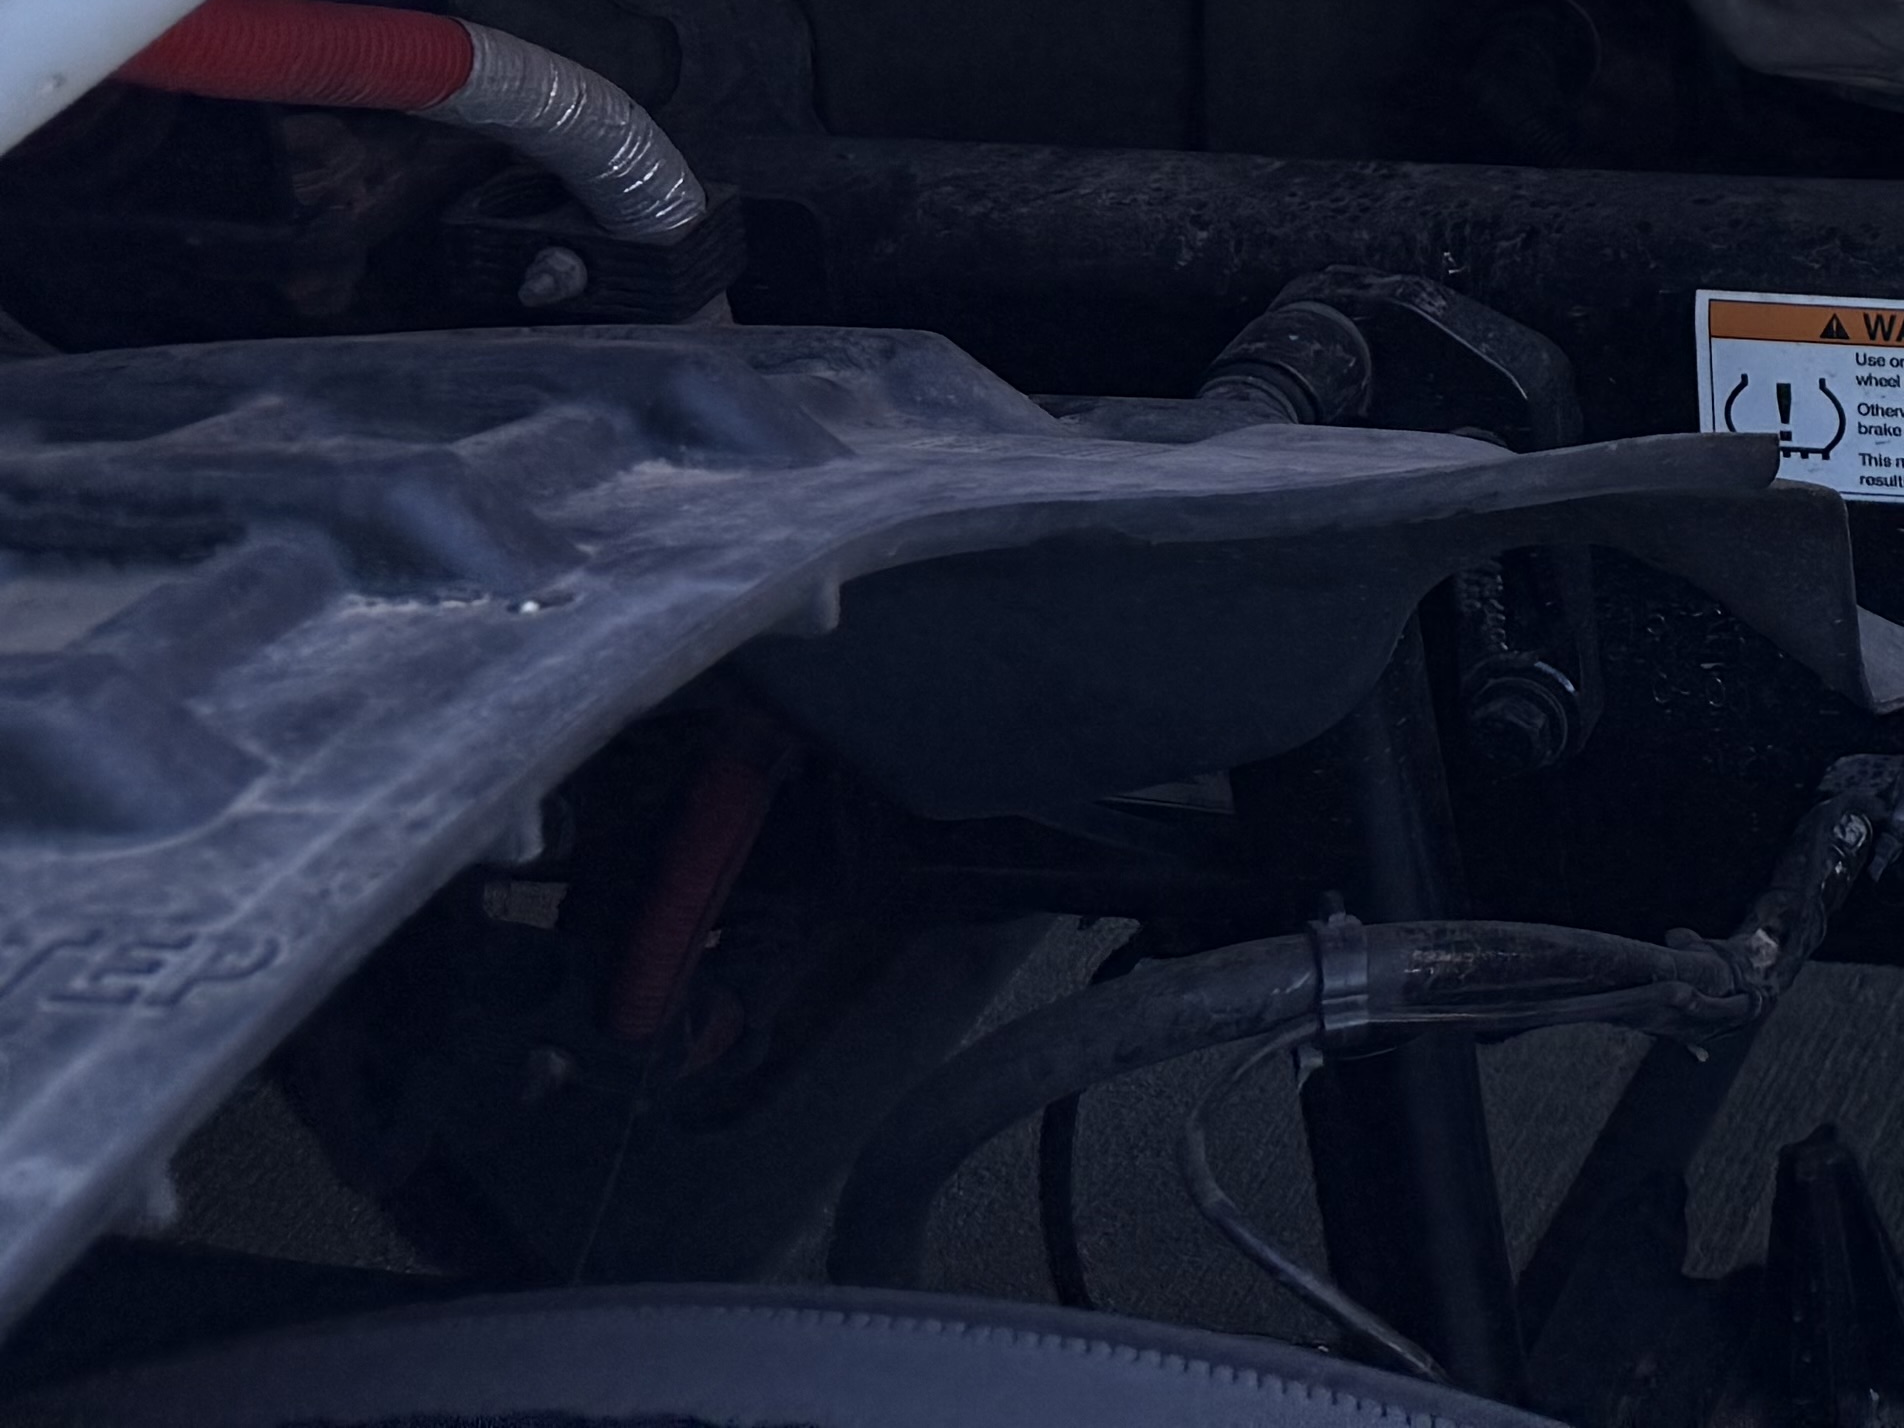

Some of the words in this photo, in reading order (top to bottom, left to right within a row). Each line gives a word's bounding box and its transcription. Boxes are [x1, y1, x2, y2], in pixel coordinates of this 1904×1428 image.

[1855, 352, 1886, 369] Use
[1855, 373, 1901, 390] wheel
[1857, 421, 1903, 438] brake
[1858, 452, 1893, 468] This
